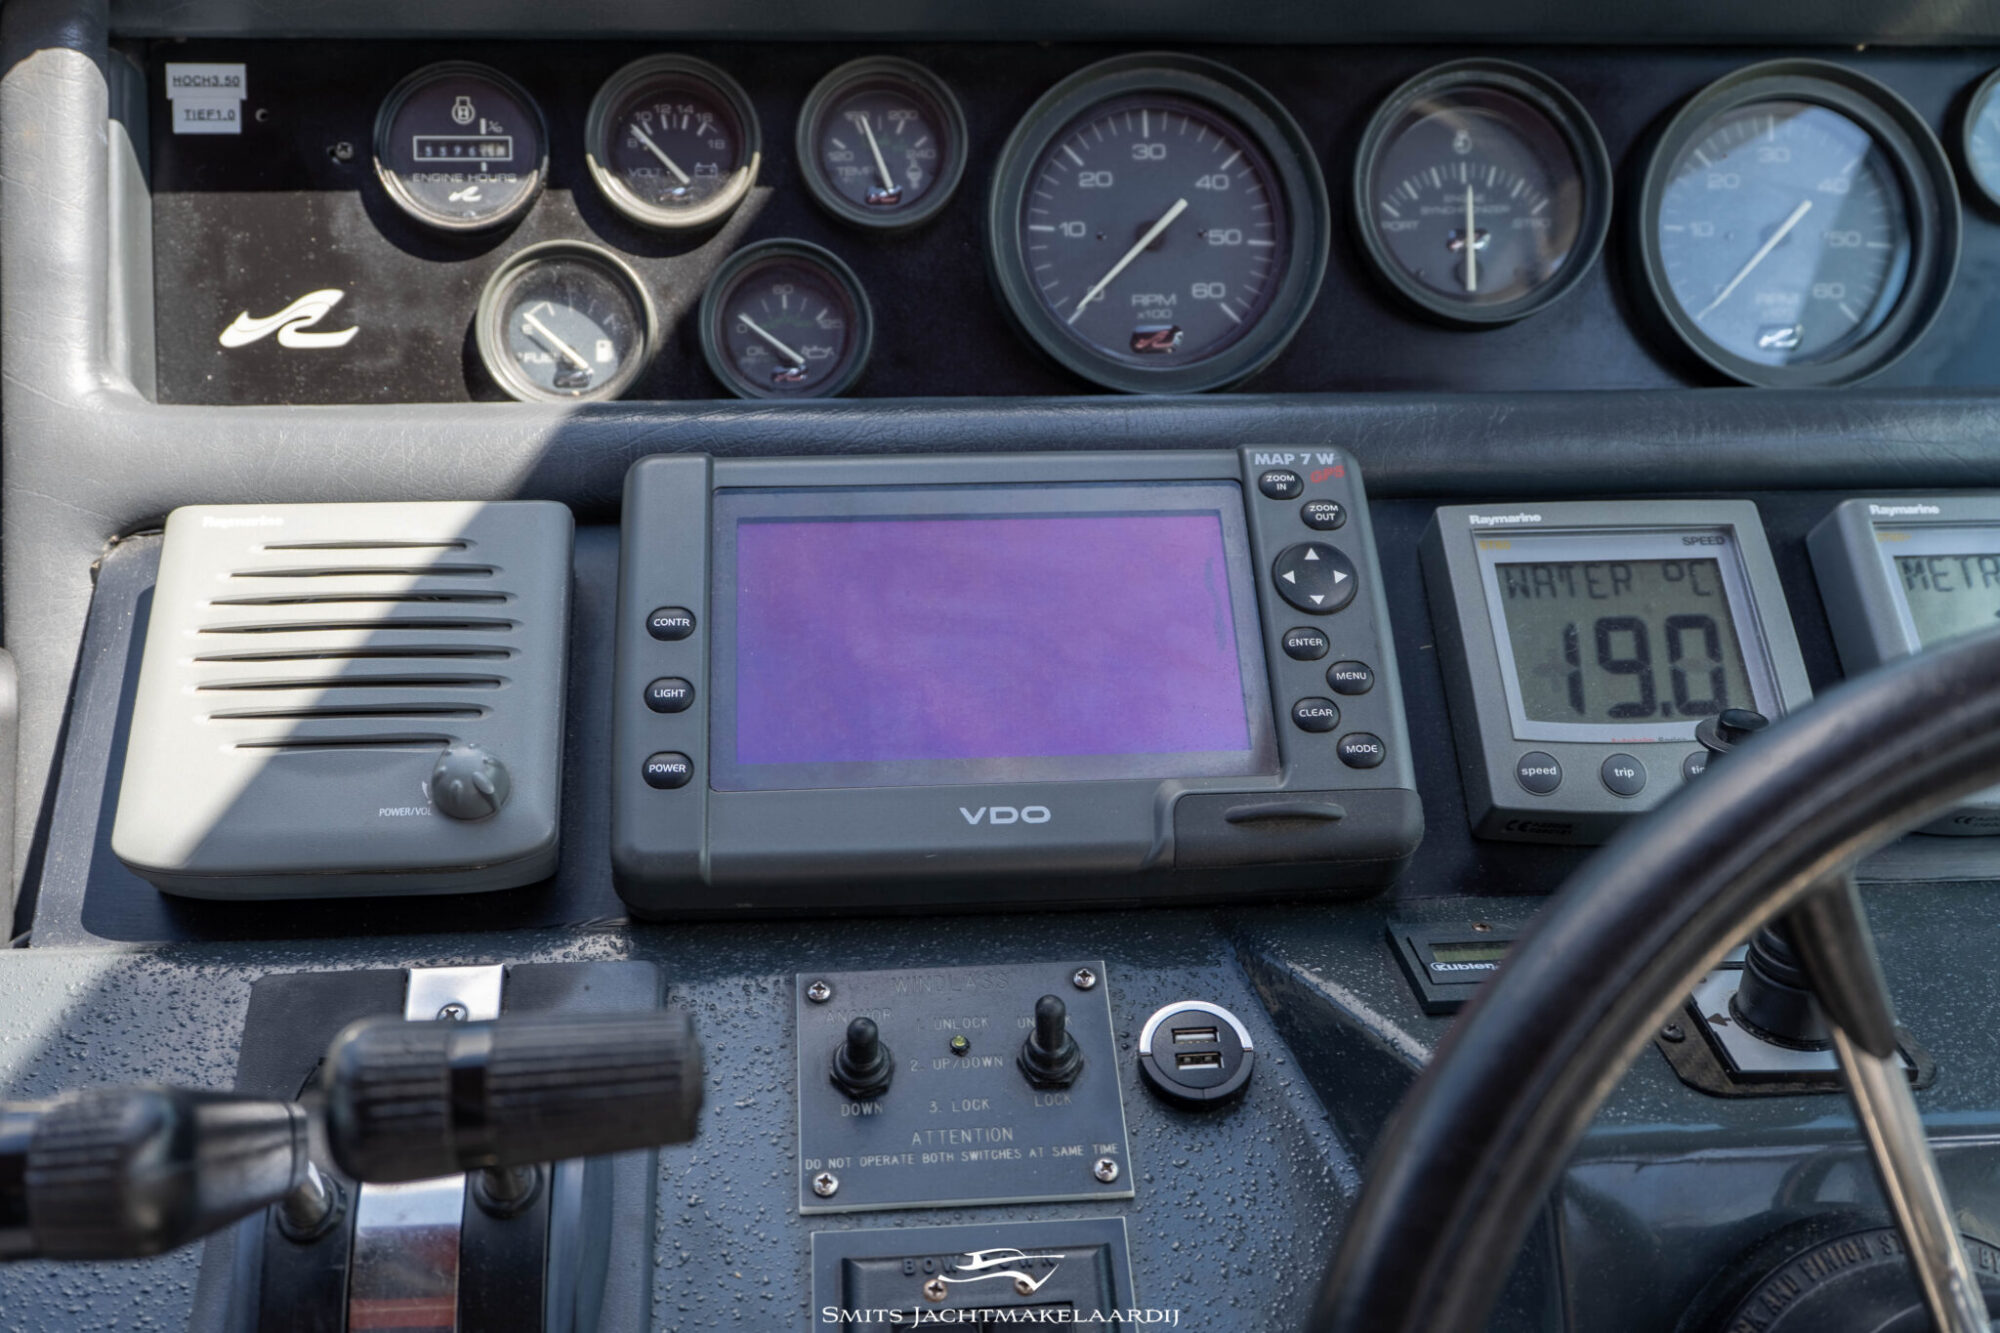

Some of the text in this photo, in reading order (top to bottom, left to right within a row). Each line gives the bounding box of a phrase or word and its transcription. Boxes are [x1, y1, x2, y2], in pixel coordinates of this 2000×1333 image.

[172, 74, 241, 87] HOCH3.50
[184, 109, 236, 121] TIEF1.0
[653, 103, 672, 114] 12
[676, 104, 694, 115] 14
[634, 111, 653, 122] 10
[1132, 143, 1166, 160] 30
[1758, 146, 1790, 163] 30
[412, 173, 518, 183] ENGINE HOURS
[1078, 171, 1113, 187] 20
[1195, 174, 1230, 190] 40
[1706, 173, 1741, 189] 20
[1817, 178, 1851, 195] 40
[1058, 221, 1087, 237] 10
[1380, 220, 1419, 231] PORT
[1690, 221, 1715, 237] 10
[1207, 229, 1242, 245] 50
[1829, 231, 1862, 247] 50
[1191, 282, 1226, 299] 60
[1813, 283, 1845, 299] 60
[1131, 293, 1177, 307] RPM
[1254, 453, 1335, 465] MAP 7 W
[1310, 465, 1345, 483] GPS
[1276, 483, 1287, 491] IN
[1315, 513, 1335, 521] OUT
[1868, 504, 1940, 517] Raymarine
[1468, 513, 1542, 525] Raymarine
[1682, 535, 1726, 546] SPEED
[1505, 562, 1632, 599] WATER
[653, 617, 691, 627] CONTR
[1288, 637, 1323, 647] ENTER
[1563, 614, 1728, 718] 19.0
[1336, 671, 1367, 681] MENU
[654, 688, 686, 698] LIGHT
[1298, 708, 1334, 718] CLEAR
[1345, 744, 1379, 754] MODE
[648, 763, 687, 774] POWER
[1521, 765, 1558, 777] speed
[1614, 766, 1635, 778] trip
[958, 805, 1051, 825] VDO
[934, 1017, 990, 1030] UNLOCK
[932, 1055, 1004, 1071] UP/DOWN
[952, 1098, 991, 1112] LOCK
[1034, 1094, 1073, 1108] LOCK
[840, 1102, 884, 1117] DOWN
[911, 1127, 1014, 1146] ATTENTION
[805, 1142, 1119, 1170] DO NOT OPERATE BOTH SWITCHES AT SAME TIME
